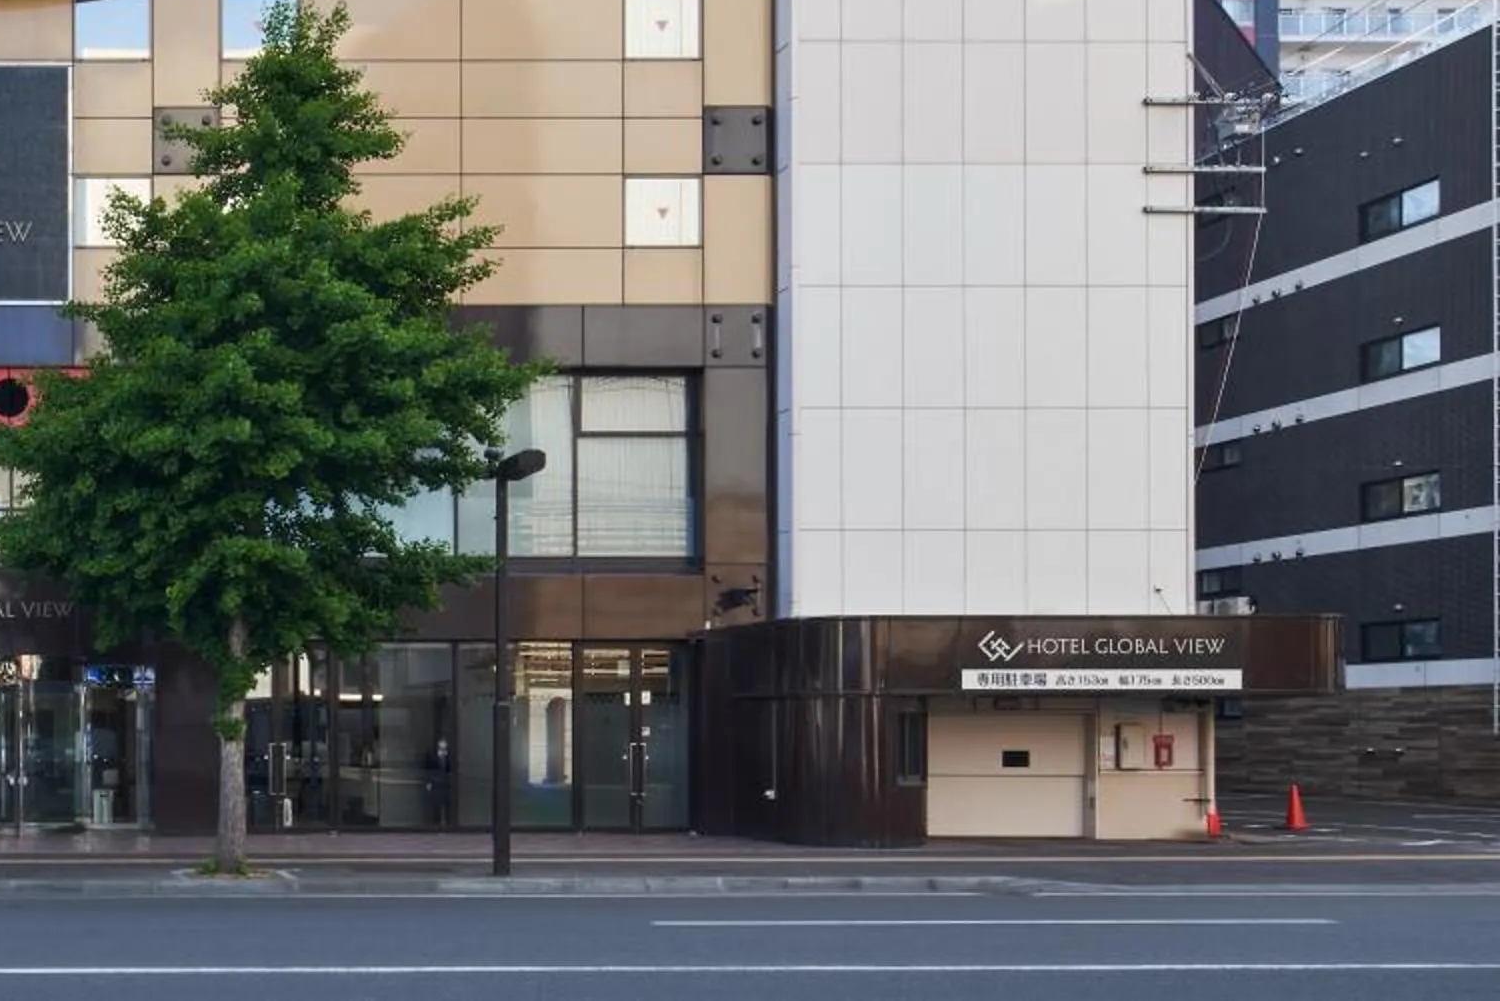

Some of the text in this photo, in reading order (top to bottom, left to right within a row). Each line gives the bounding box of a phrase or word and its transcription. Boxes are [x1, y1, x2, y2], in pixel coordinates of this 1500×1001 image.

[20, 600, 75, 619] VIEW
[1026, 637, 1226, 655] HOTEL GLOBAL VIEW
[976, 671, 1048, 688] 専用駐車場
